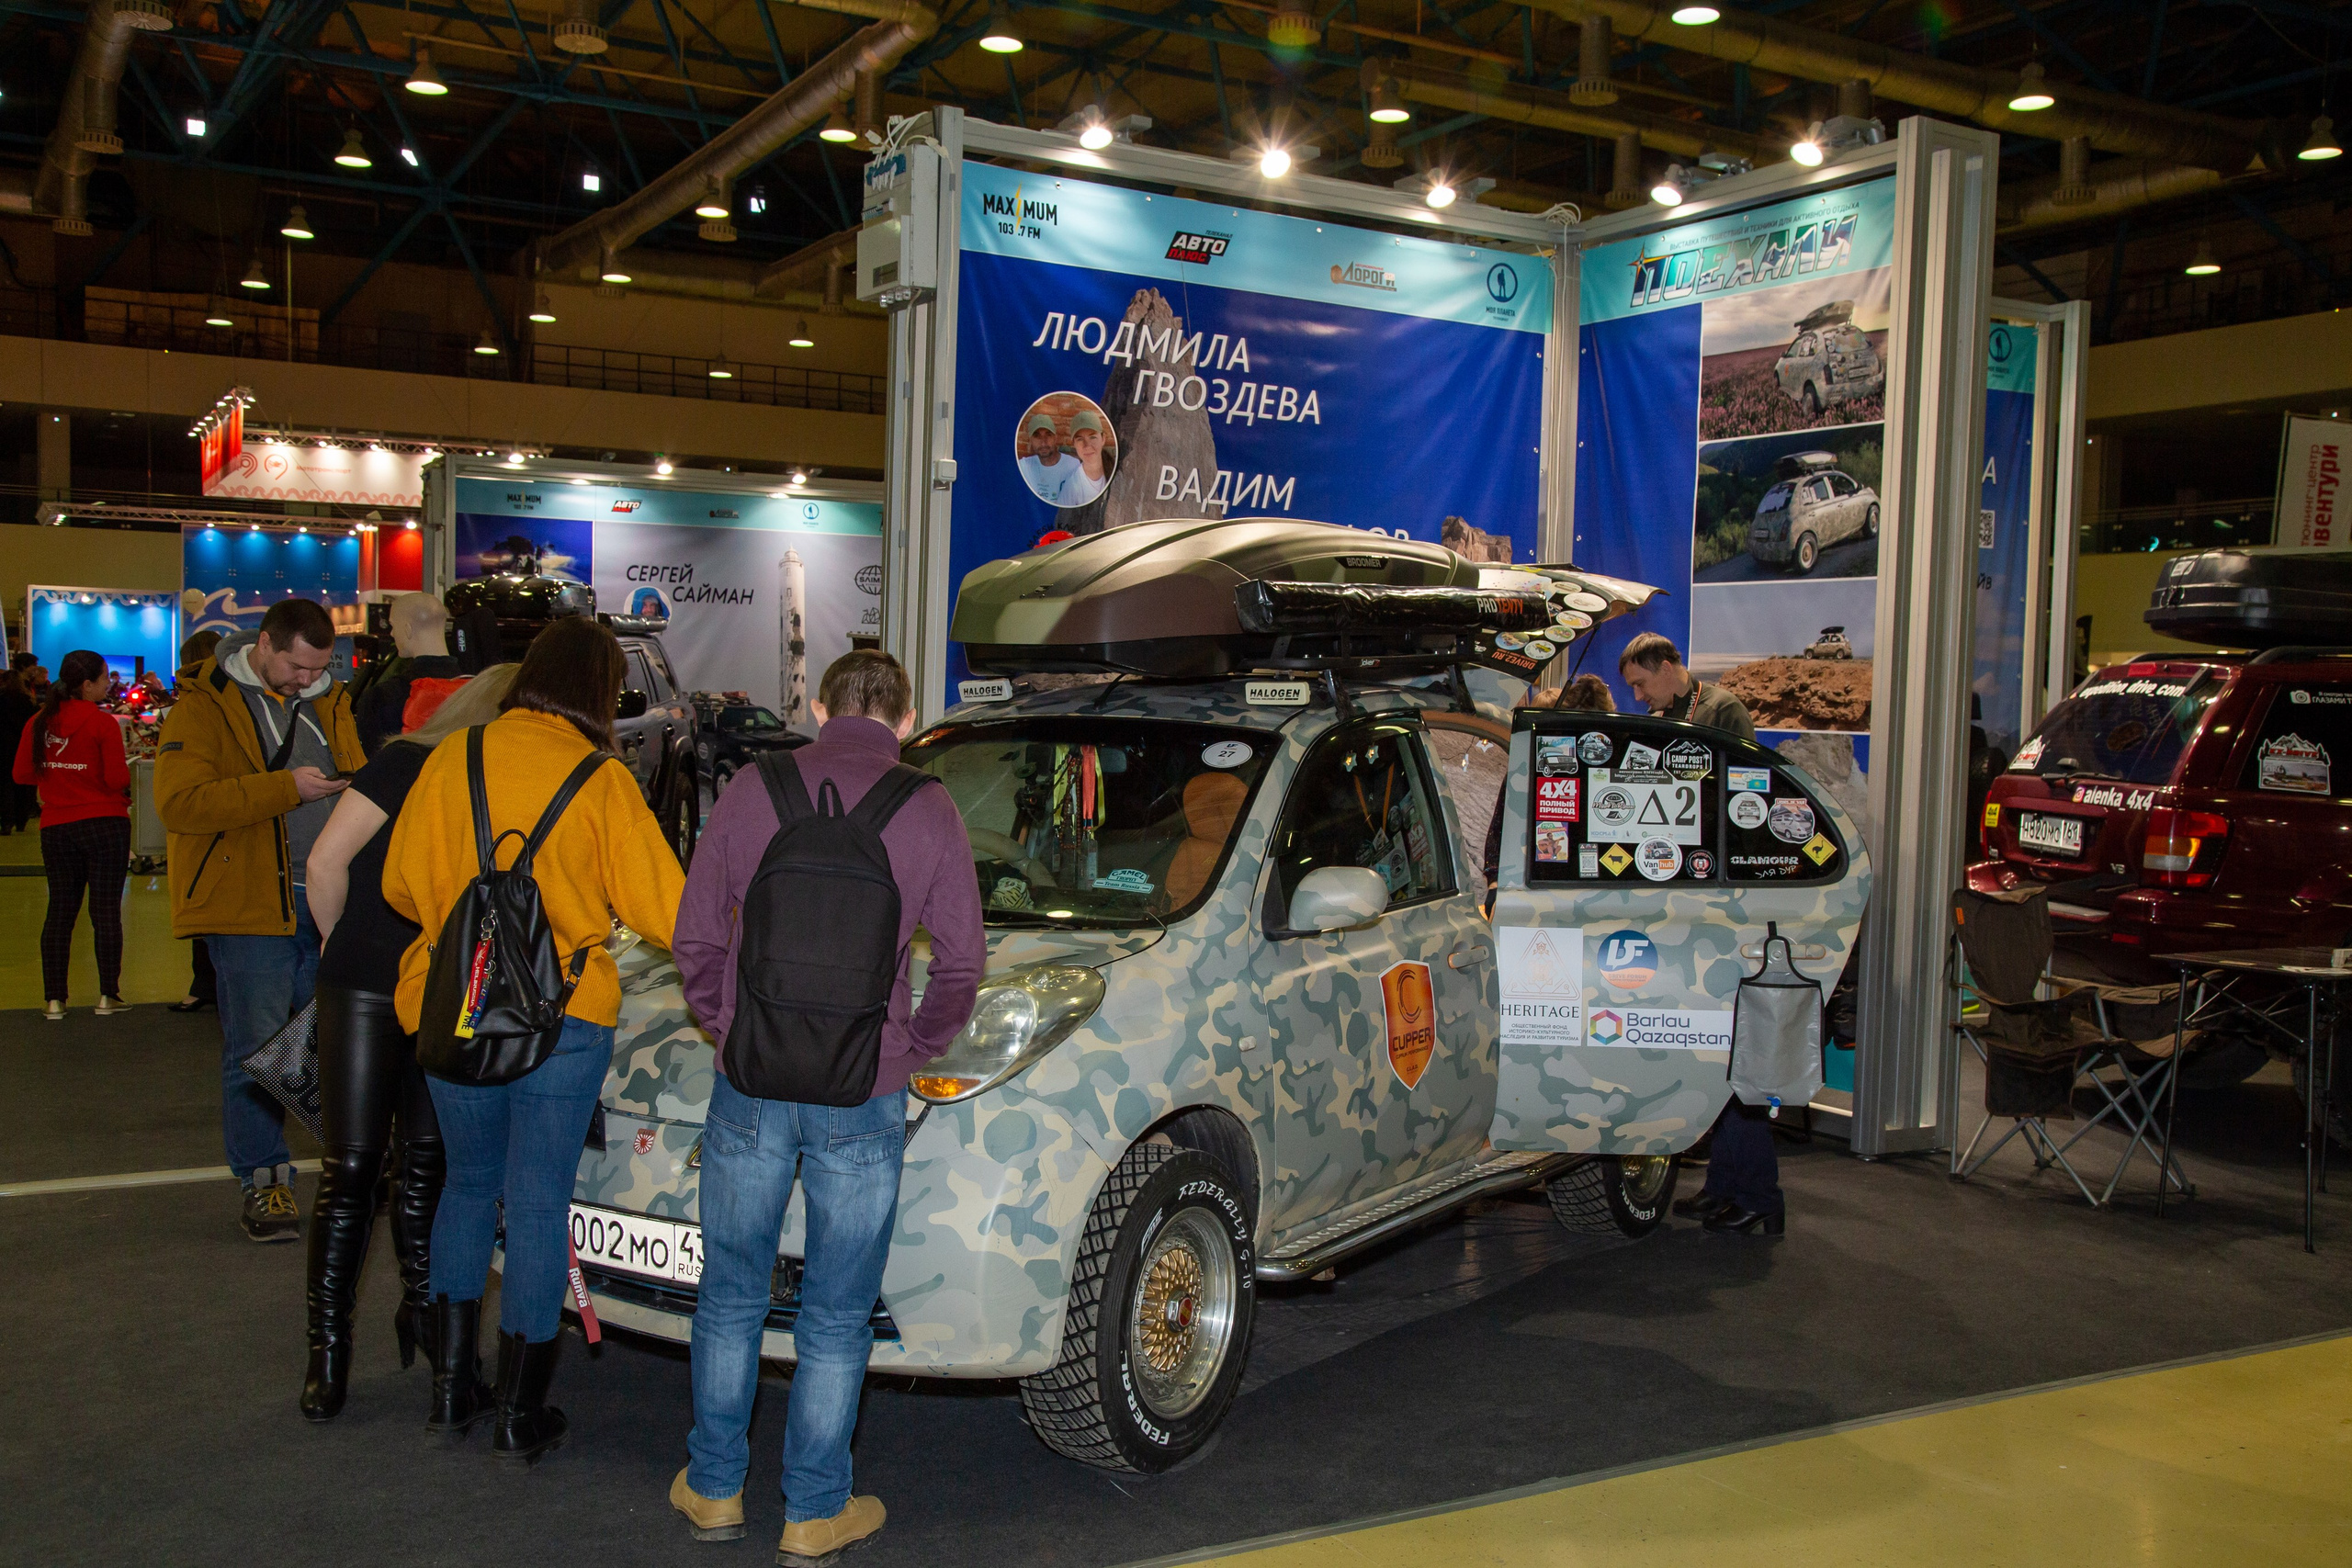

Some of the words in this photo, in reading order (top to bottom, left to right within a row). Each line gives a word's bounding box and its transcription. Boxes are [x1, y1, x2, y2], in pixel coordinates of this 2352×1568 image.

[1027, 226, 1041, 240] FM
[1669, 237, 1700, 252] ВЫСТАВКА
[1700, 227, 1744, 244] ПУТЕШЕСТВИЙ
[1750, 220, 1778, 232] ТЕХНИКИ
[1778, 217, 1792, 229] ДЛЯ
[1792, 208, 1831, 224] АКТИВНОГО
[1832, 201, 1860, 215] ОТДЫХА
[1172, 233, 1227, 254] АВТО
[1033, 311, 1250, 373] ЛЮДМИЛА
[1133, 369, 1322, 427] ГВОЗДЕВА
[1156, 465, 1296, 515] ВАДИМ
[2313, 444, 2341, 547] вентури
[1346, 557, 1383, 569] BROOMER
[626, 561, 695, 584] СЕРГЕЙ
[672, 582, 755, 606] САЙМАН
[1476, 597, 1524, 615] PROTENTY
[963, 685, 1003, 696] HALOGEN
[1250, 689, 1301, 698] HALOGEN
[1217, 750, 1237, 758] 27
[1671, 754, 1688, 763] CAMP
[1689, 754, 1703, 764] POST
[1539, 800, 1576, 808] ПОЛНЫЙ
[1539, 807, 1576, 816] ПРИВОД
[1675, 786, 1697, 826] 2
[1659, 860, 1674, 868] hub
[1730, 855, 1799, 865] GLAMOUR
[1111, 870, 1145, 880] CAMEL
[1501, 1004, 1579, 1019] HERITAGE
[1626, 1012, 1690, 1028] Barlau
[1392, 1026, 1431, 1053] CUPPER
[1625, 1028, 1732, 1048] Qazaqstan
[677, 1262, 702, 1278] RUS
[569, 1266, 590, 1308] Runva
[1120, 1349, 1170, 1446] FEDERAL
